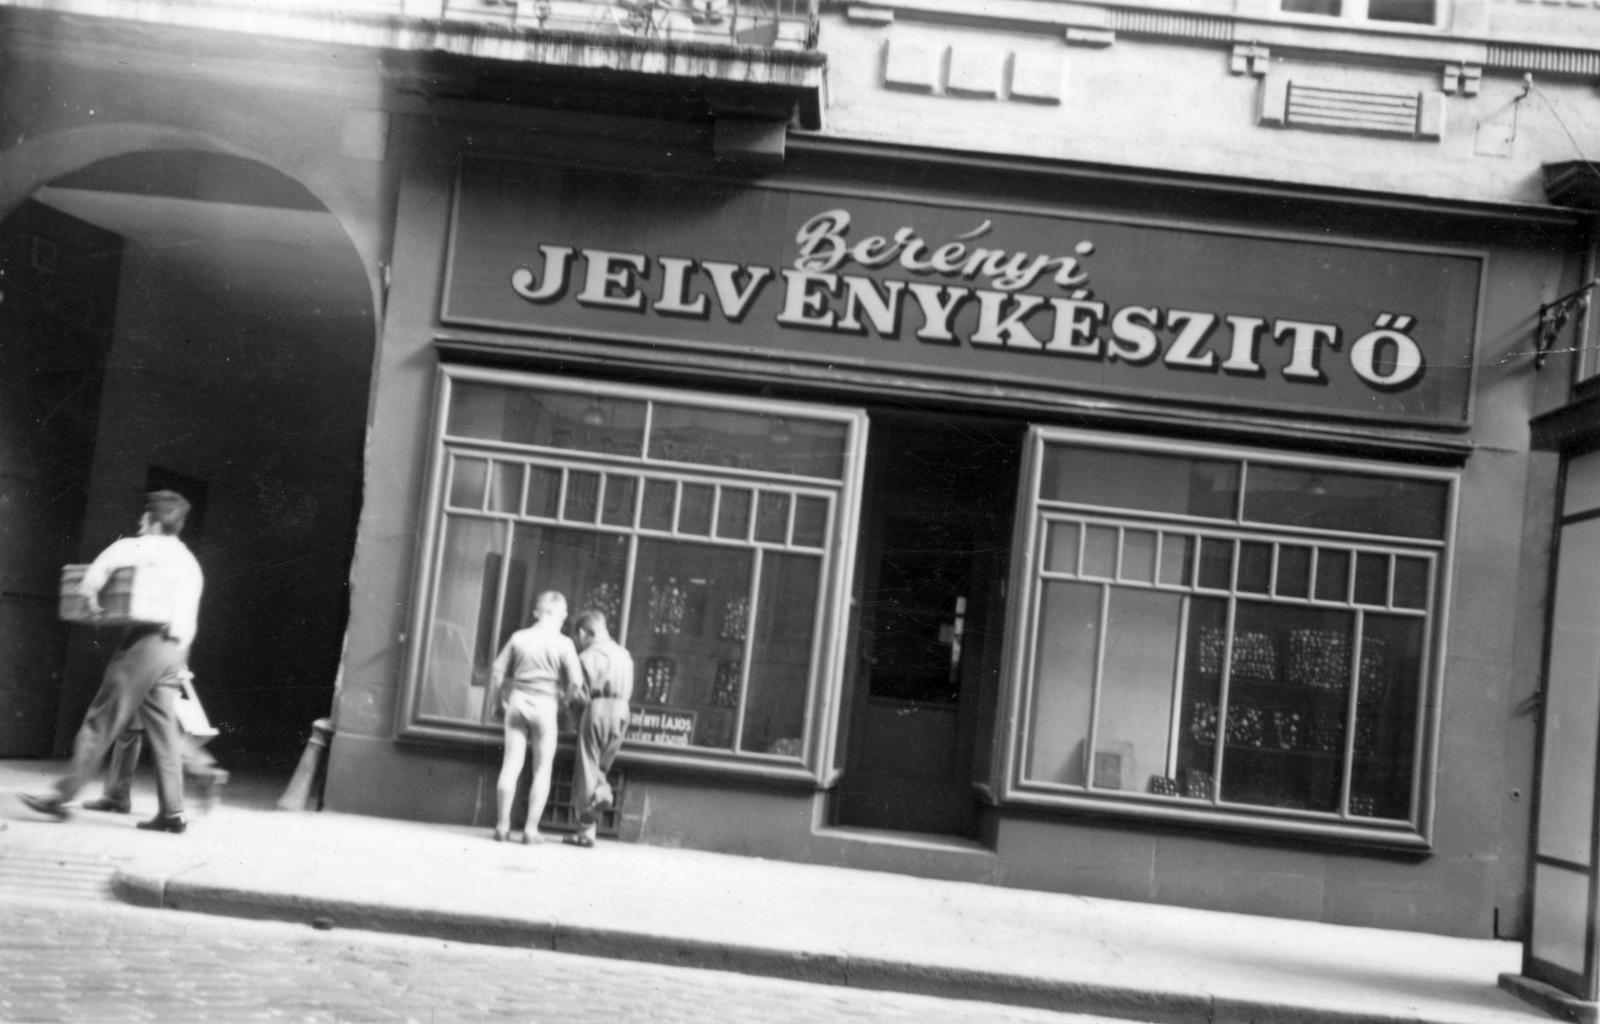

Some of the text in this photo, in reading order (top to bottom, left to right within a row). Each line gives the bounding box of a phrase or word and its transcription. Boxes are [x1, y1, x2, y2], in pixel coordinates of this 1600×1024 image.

[793, 208, 1094, 291] Berényi
[629, 708, 692, 732] RÉNYI LAJOS
